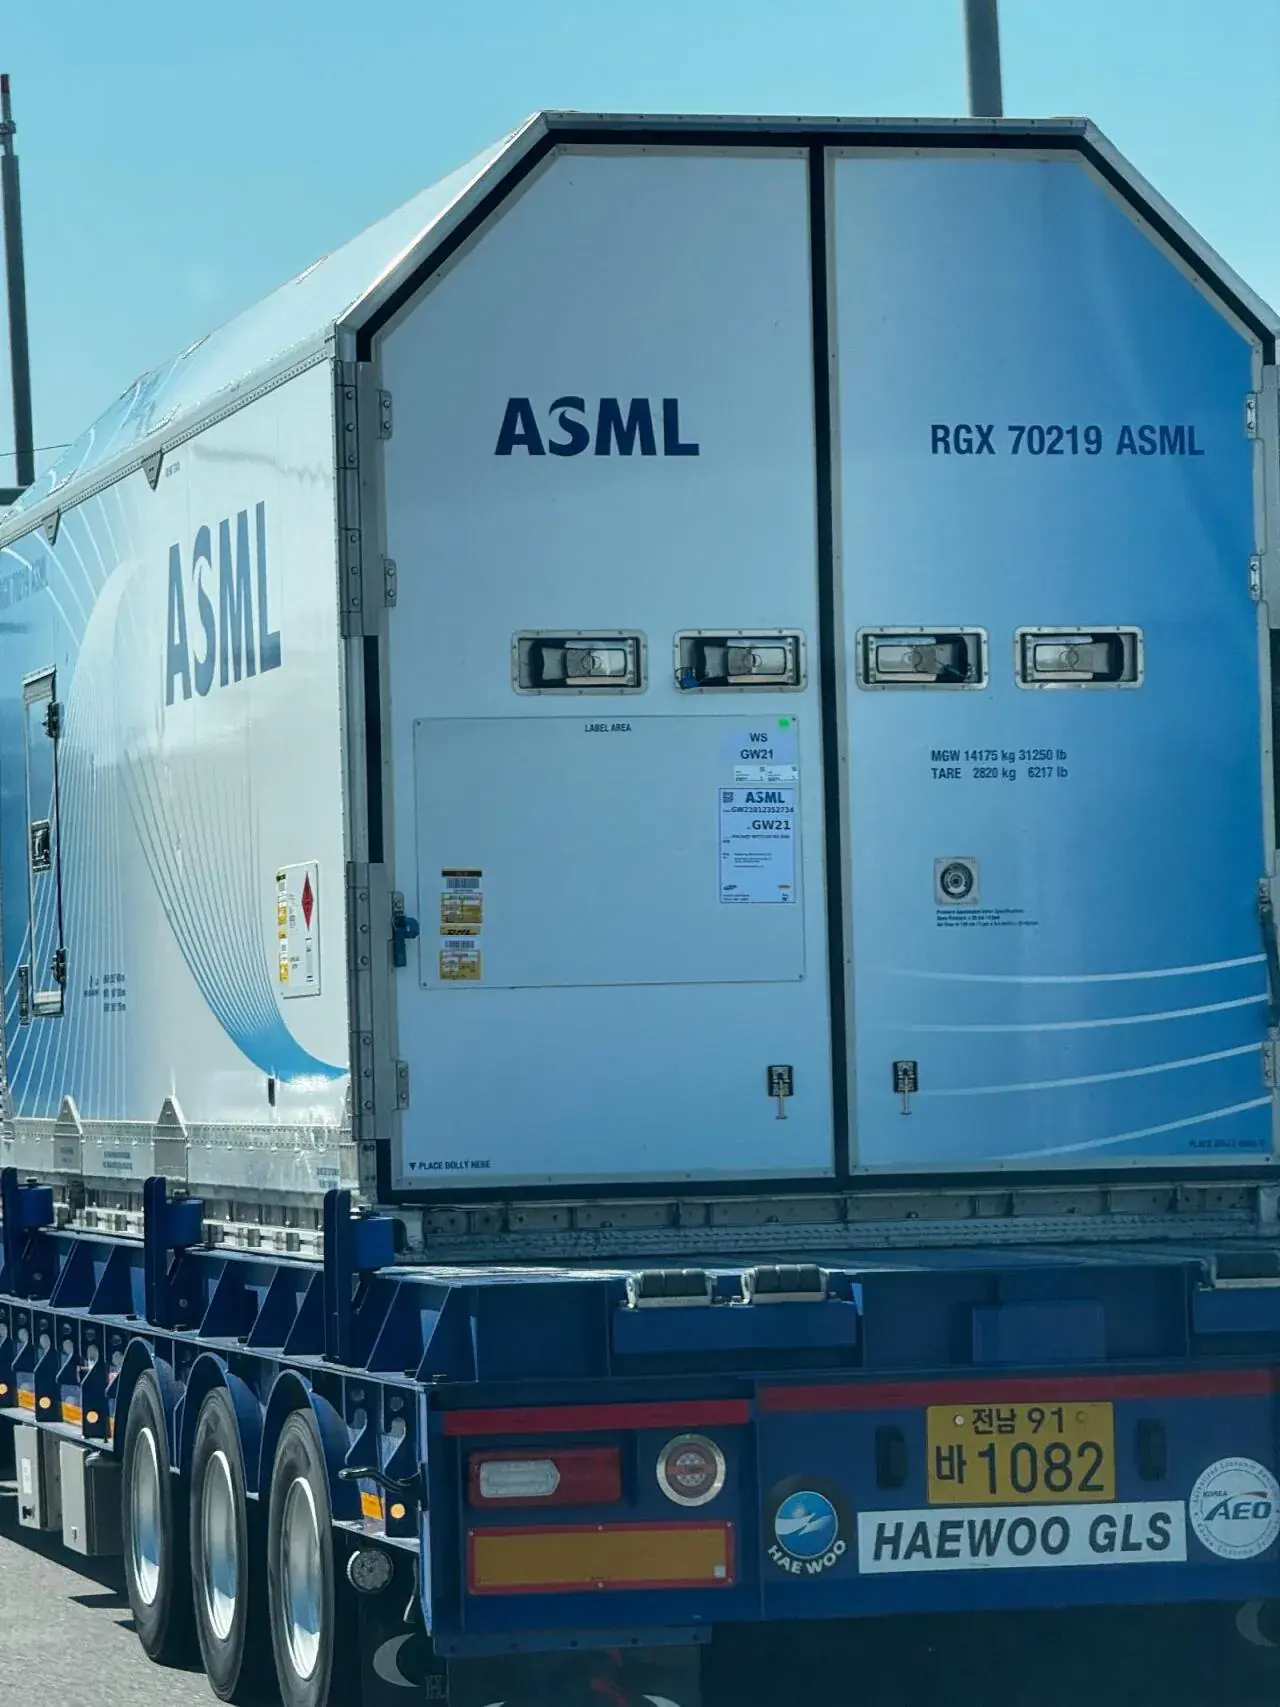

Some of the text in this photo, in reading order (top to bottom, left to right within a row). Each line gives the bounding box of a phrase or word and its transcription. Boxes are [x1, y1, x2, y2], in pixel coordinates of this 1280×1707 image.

[494, 396, 700, 457] ASML
[931, 424, 1205, 455] RGX 70219 ASML
[166, 501, 281, 706] ASML
[585, 723, 632, 732] LABEL AREA
[750, 732, 768, 742] WS
[740, 749, 774, 760] GW21
[931, 748, 1067, 763] MGW 14175 kg 31250 lb
[931, 766, 1068, 781] TARE 2820 kg 6217 lb
[745, 791, 785, 804] ASML
[752, 820, 791, 830] GW21
[419, 1162, 443, 1170] PLACE
[972, 1407, 1064, 1435] 전남 91
[1203, 1496, 1272, 1521] AEO
[873, 1516, 1070, 1561] HAEWOO
[1089, 1512, 1172, 1554] GLS
[768, 1540, 846, 1574] HAEWOO
